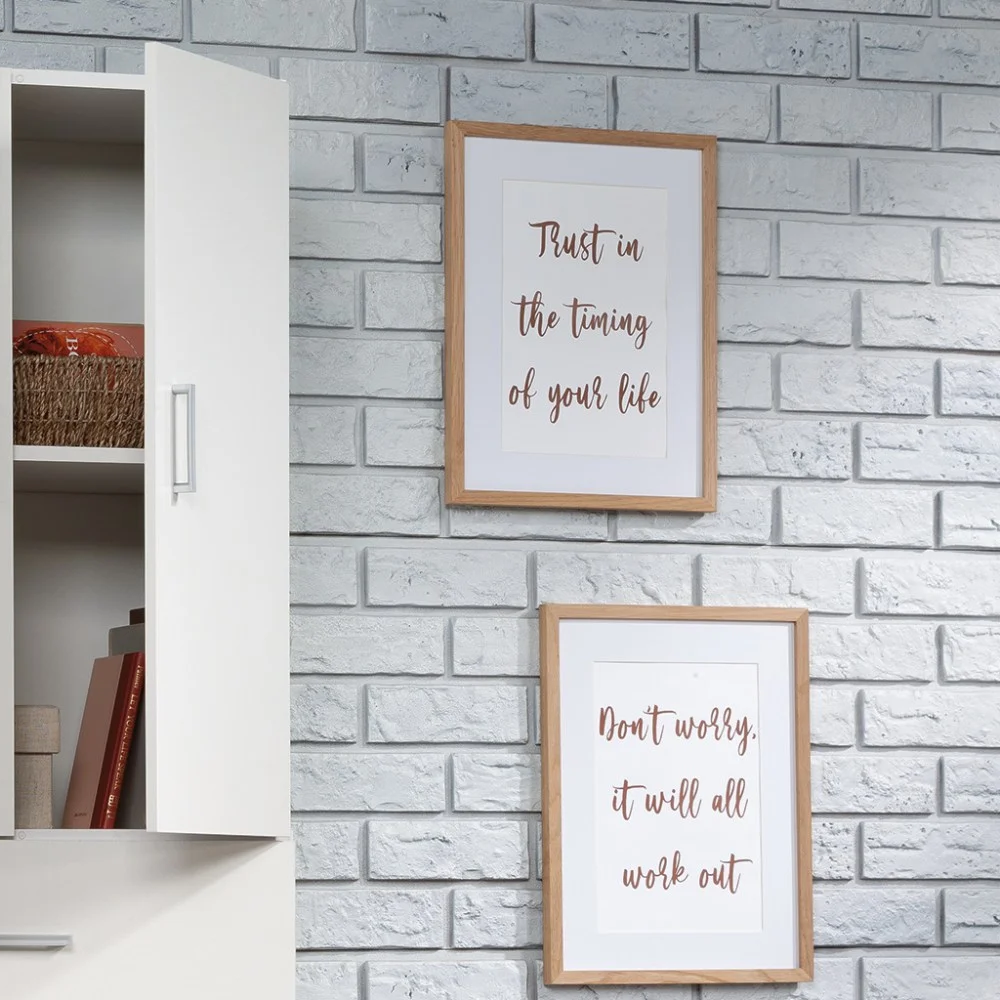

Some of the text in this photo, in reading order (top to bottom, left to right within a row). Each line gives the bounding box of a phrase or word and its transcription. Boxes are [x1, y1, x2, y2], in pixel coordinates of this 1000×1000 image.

[528, 220, 644, 265] Trust in
[510, 290, 652, 350] the timing
[508, 367, 661, 424] of your life
[599, 704, 756, 756] Don't worry,
[612, 778, 748, 821] it will all
[623, 850, 753, 894] work out
